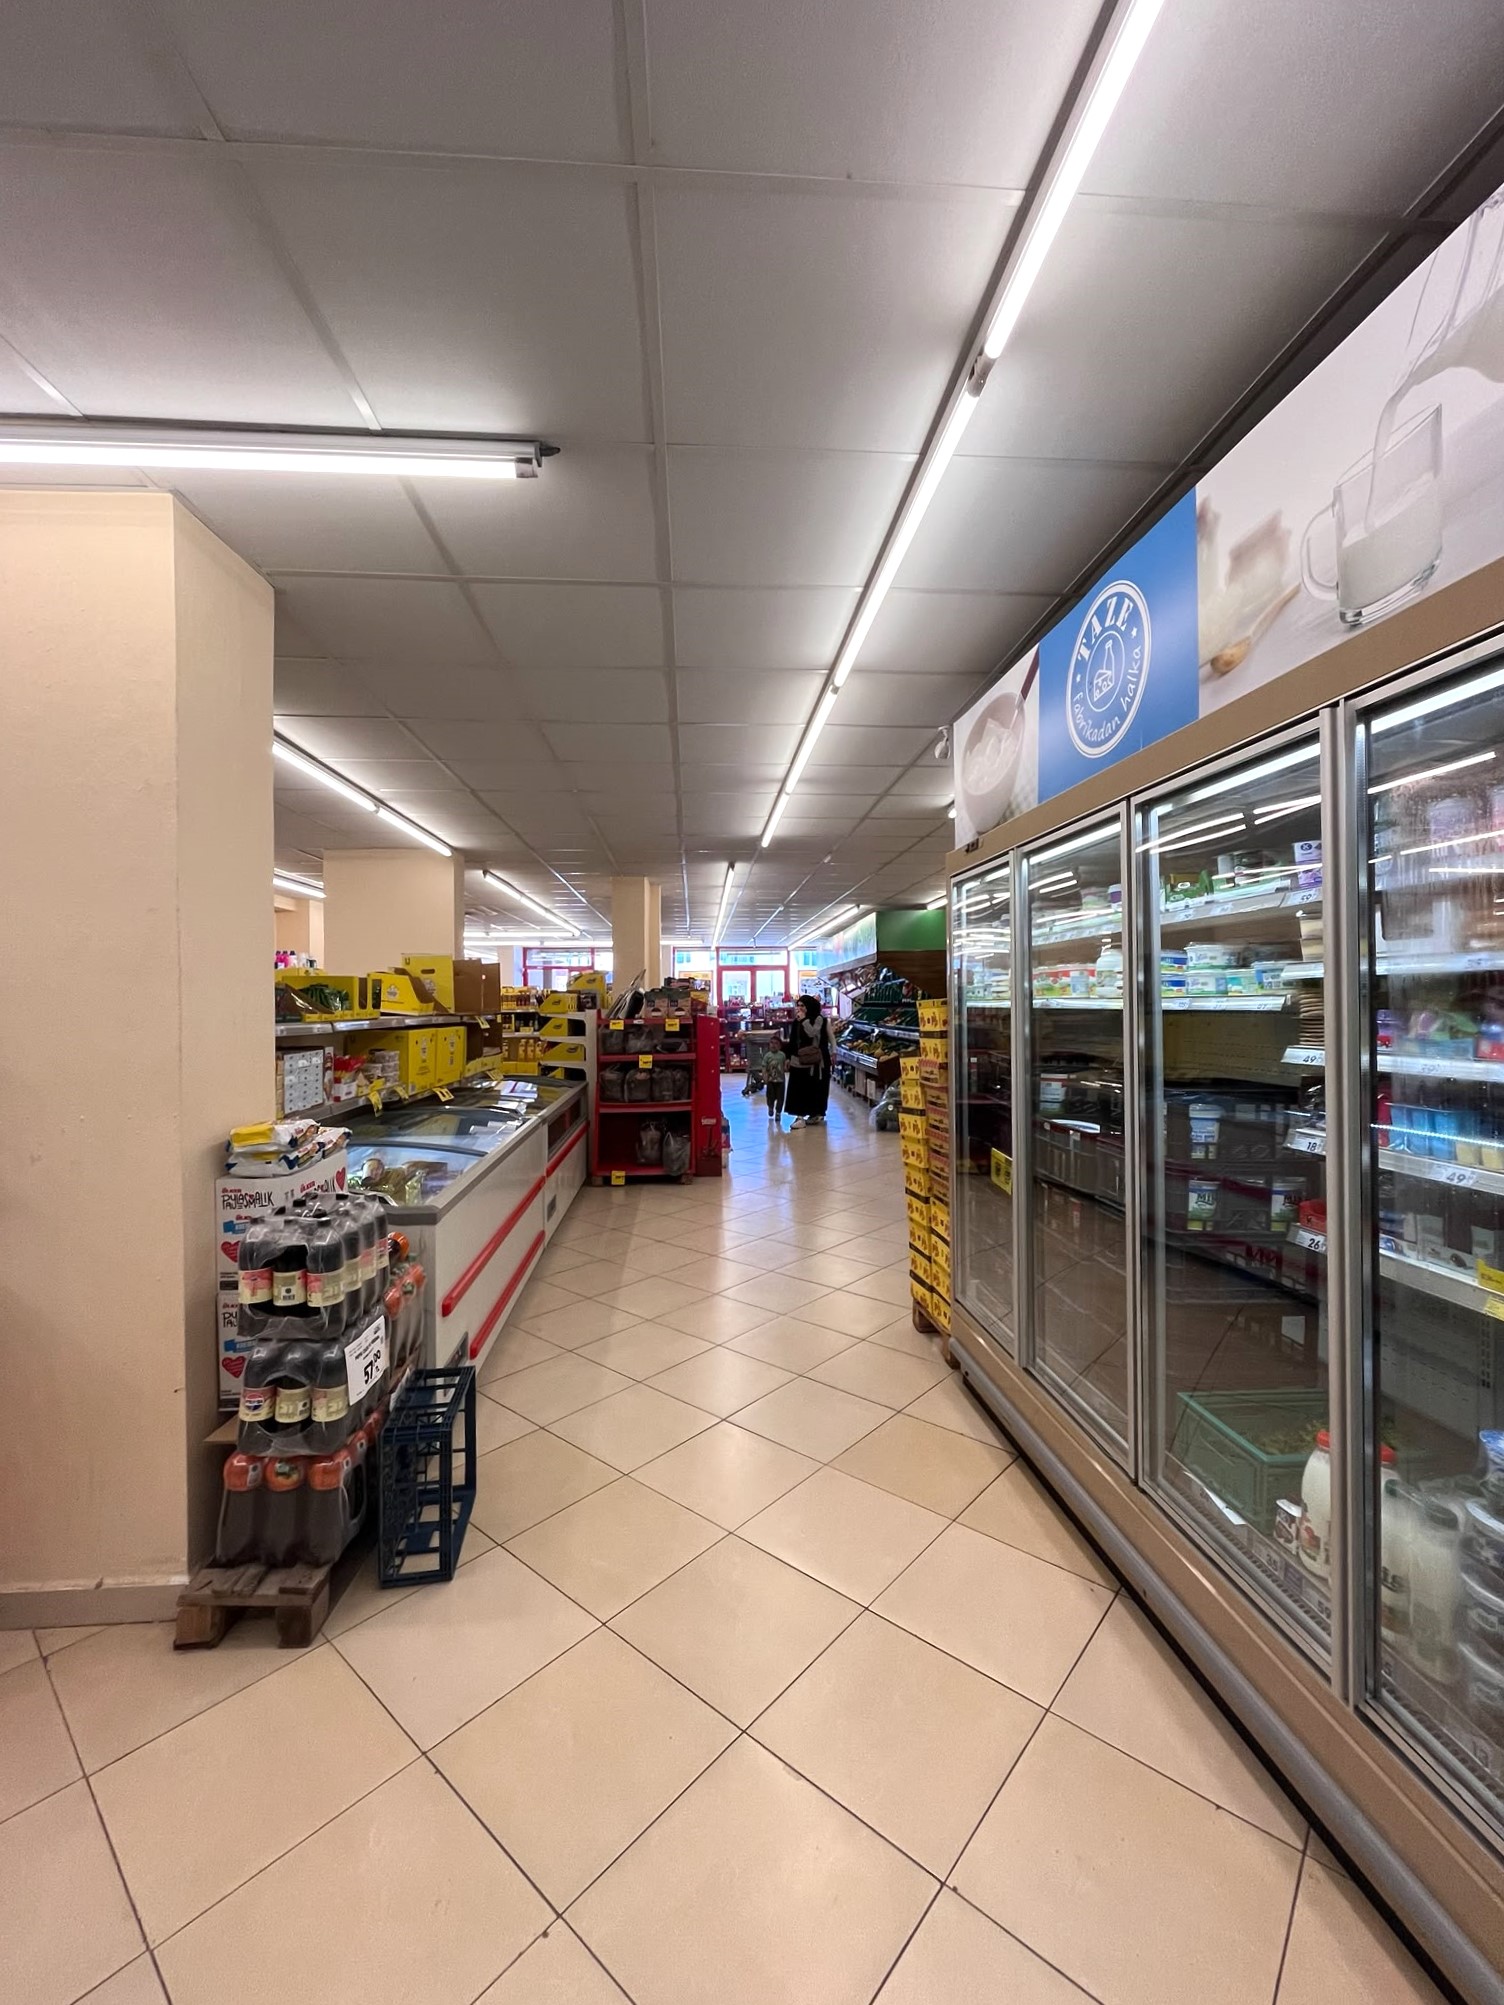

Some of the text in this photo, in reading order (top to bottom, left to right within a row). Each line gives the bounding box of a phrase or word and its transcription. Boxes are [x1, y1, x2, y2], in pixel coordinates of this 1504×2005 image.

[1077, 596, 1134, 663] TAZE
[1120, 645, 1142, 712] halka
[1307, 1141, 1317, 1151] 18
[1446, 1171, 1466, 1184] 49
[1307, 1237, 1321, 1250] 26
